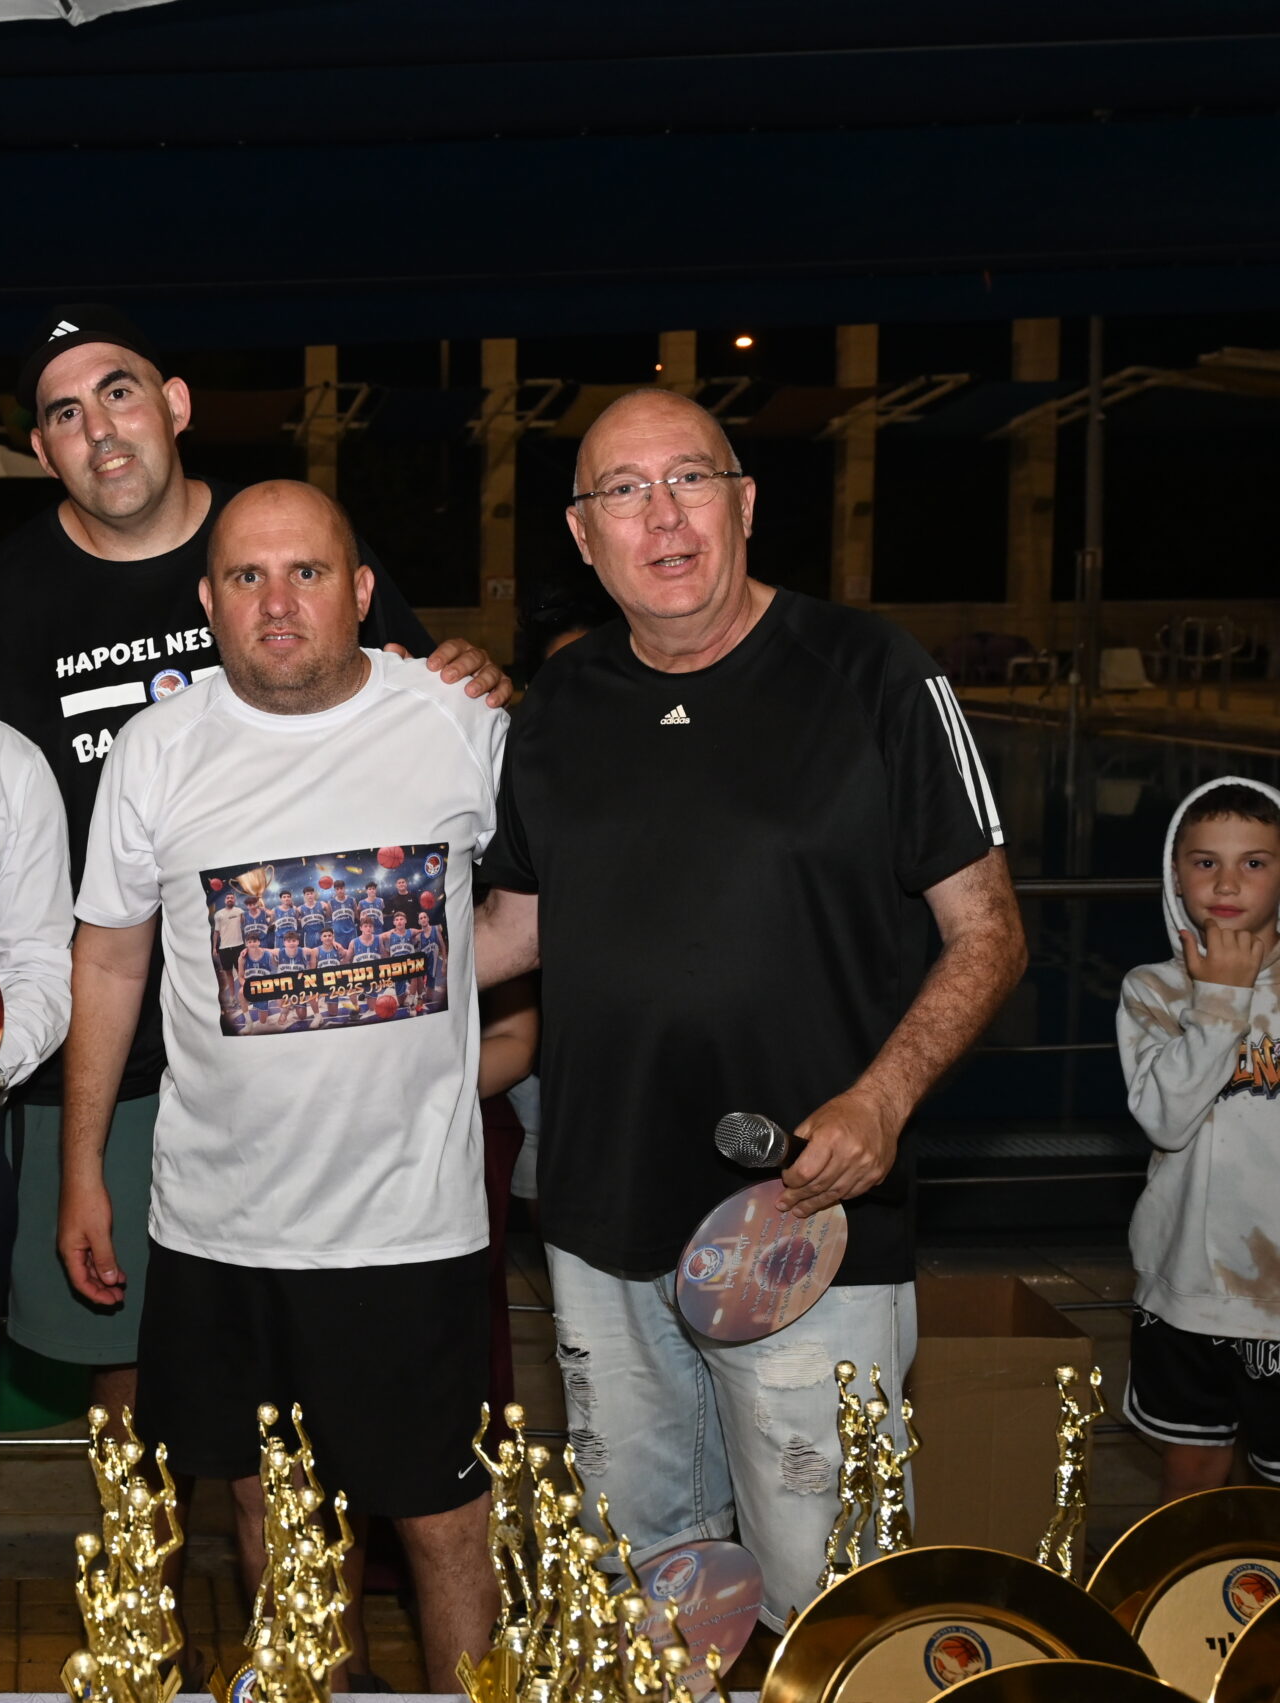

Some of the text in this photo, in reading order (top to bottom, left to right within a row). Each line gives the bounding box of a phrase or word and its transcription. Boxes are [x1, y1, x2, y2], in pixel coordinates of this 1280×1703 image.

[55, 637, 162, 679] HAPOEL
[164, 626, 214, 656] NES
[660, 716, 691, 725] adidas
[71, 728, 114, 764] BA
[322, 966, 375, 987] נערים
[378, 957, 426, 979] אלופת
[249, 976, 294, 996] חיפה
